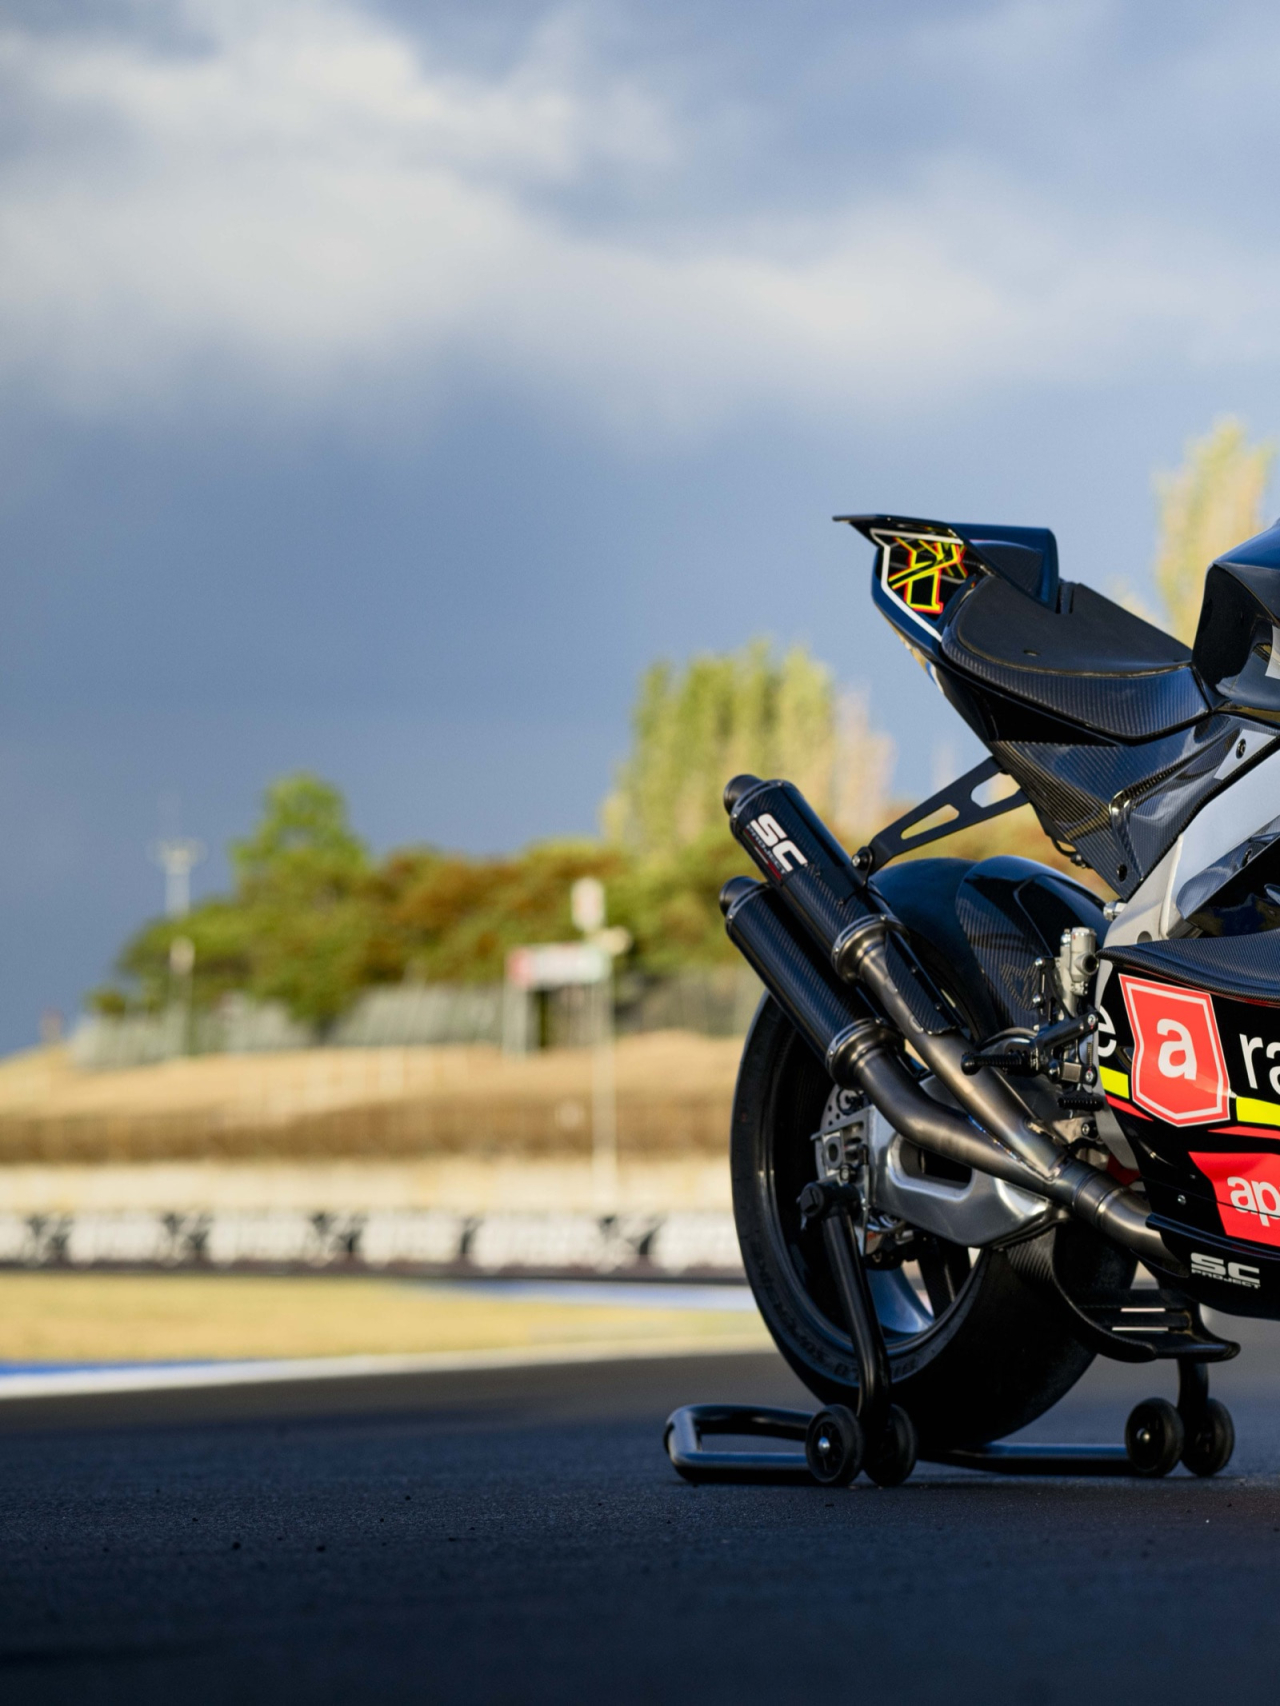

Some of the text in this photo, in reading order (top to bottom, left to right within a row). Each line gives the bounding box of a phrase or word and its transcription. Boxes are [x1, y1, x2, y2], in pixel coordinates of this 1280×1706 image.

[750, 813, 808, 873] SC
[1157, 1017, 1198, 1082] a
[1190, 1252, 1260, 1284] SC
